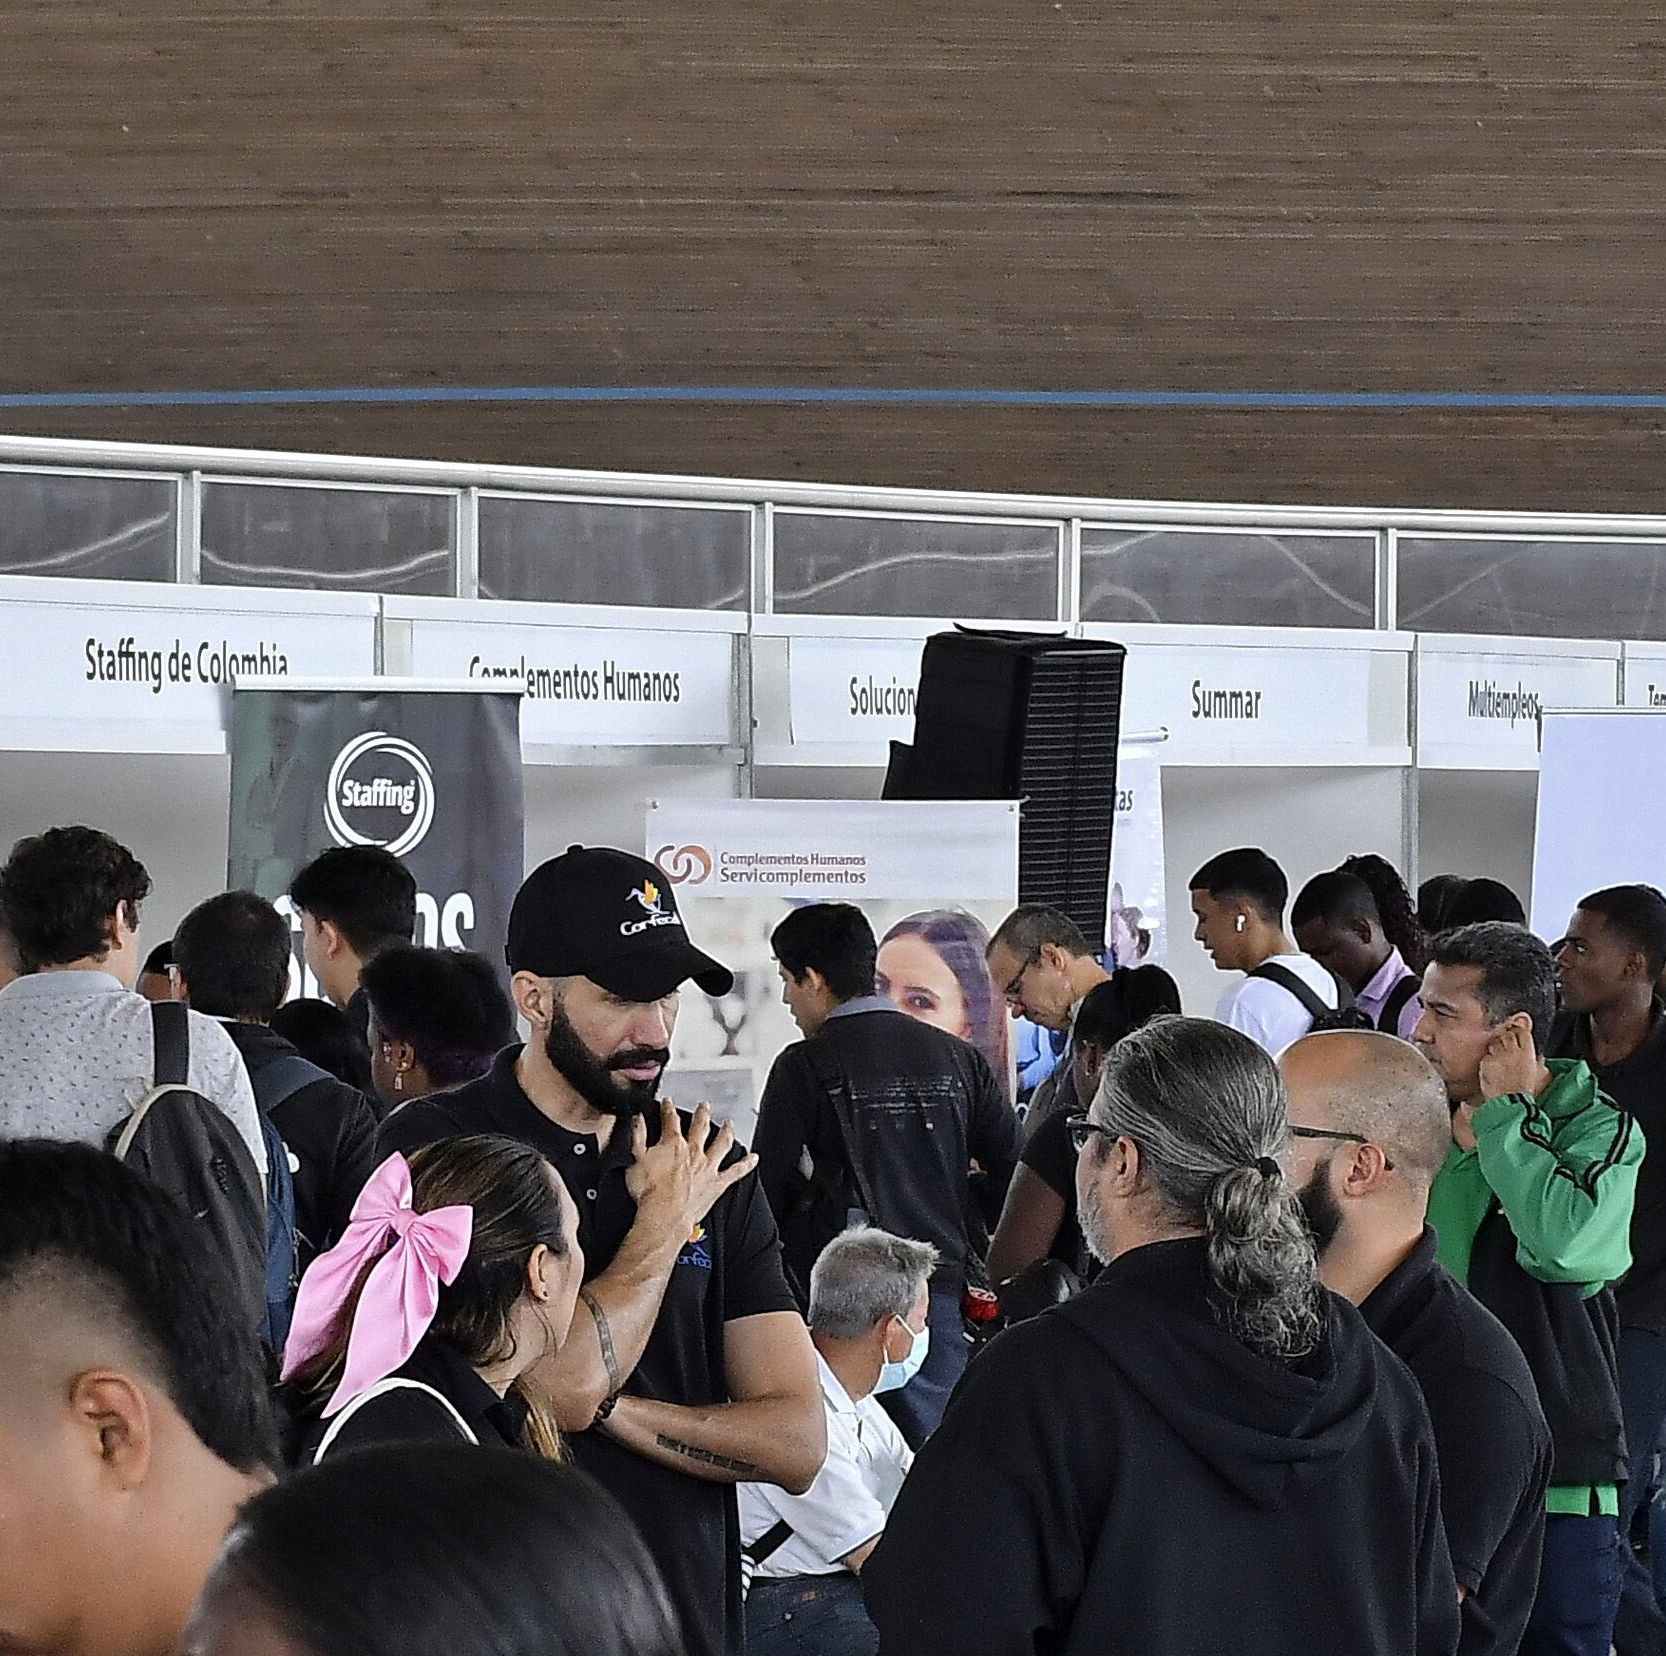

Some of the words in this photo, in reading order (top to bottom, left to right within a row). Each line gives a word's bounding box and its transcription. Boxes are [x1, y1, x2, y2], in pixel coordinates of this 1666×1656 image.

[86, 637, 162, 694] Staffing
[168, 638, 191, 683] de
[603, 660, 680, 702] Humanos
[849, 675, 917, 717] Solucion
[1191, 680, 1262, 719] Summar
[1468, 680, 1539, 729] Multiempleos
[342, 779, 416, 815] Staffing
[720, 852, 808, 866] Complementos
[811, 853, 866, 866] Humanos
[721, 868, 866, 885] Servicomplementos
